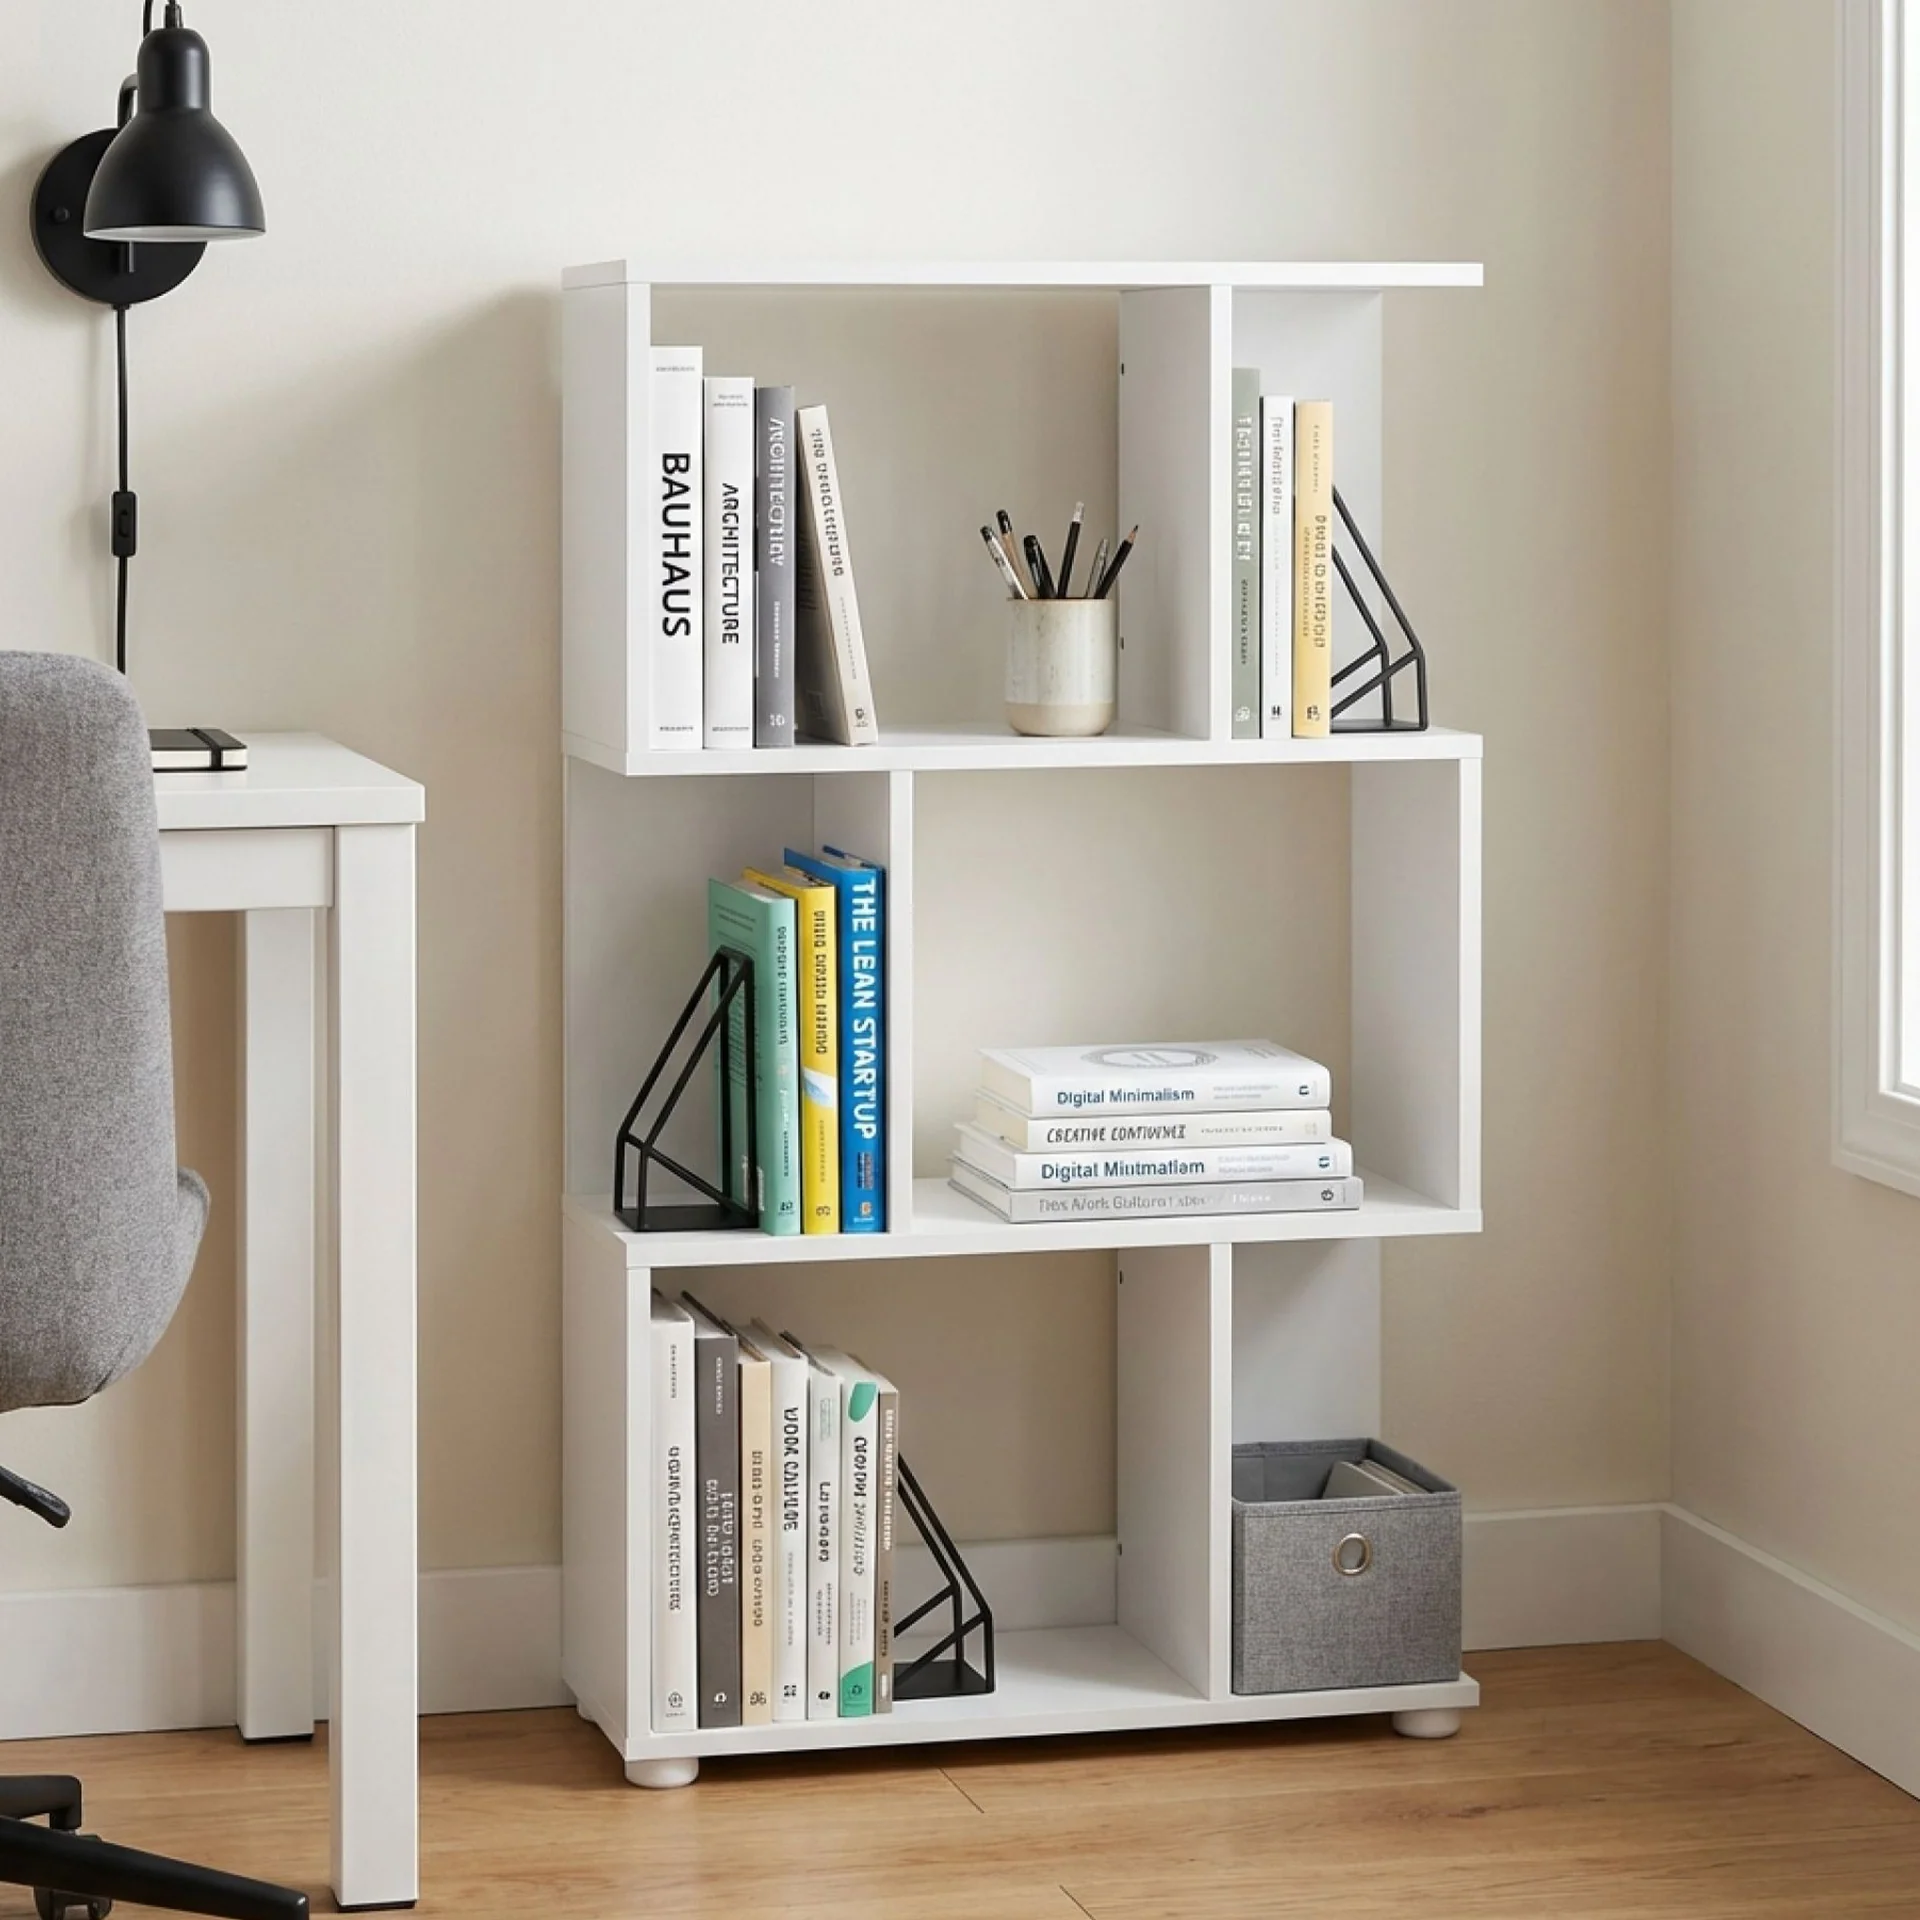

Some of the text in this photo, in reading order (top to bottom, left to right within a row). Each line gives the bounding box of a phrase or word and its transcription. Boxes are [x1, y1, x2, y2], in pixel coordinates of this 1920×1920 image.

[661, 452, 691, 637] BAUHAUS
[851, 877, 877, 932] THE
[851, 941, 877, 1009] LEAN
[852, 1017, 877, 1140] STARTUP
[1109, 1088, 1195, 1103] Minimalism
[1041, 1163, 1099, 1183] Digital
